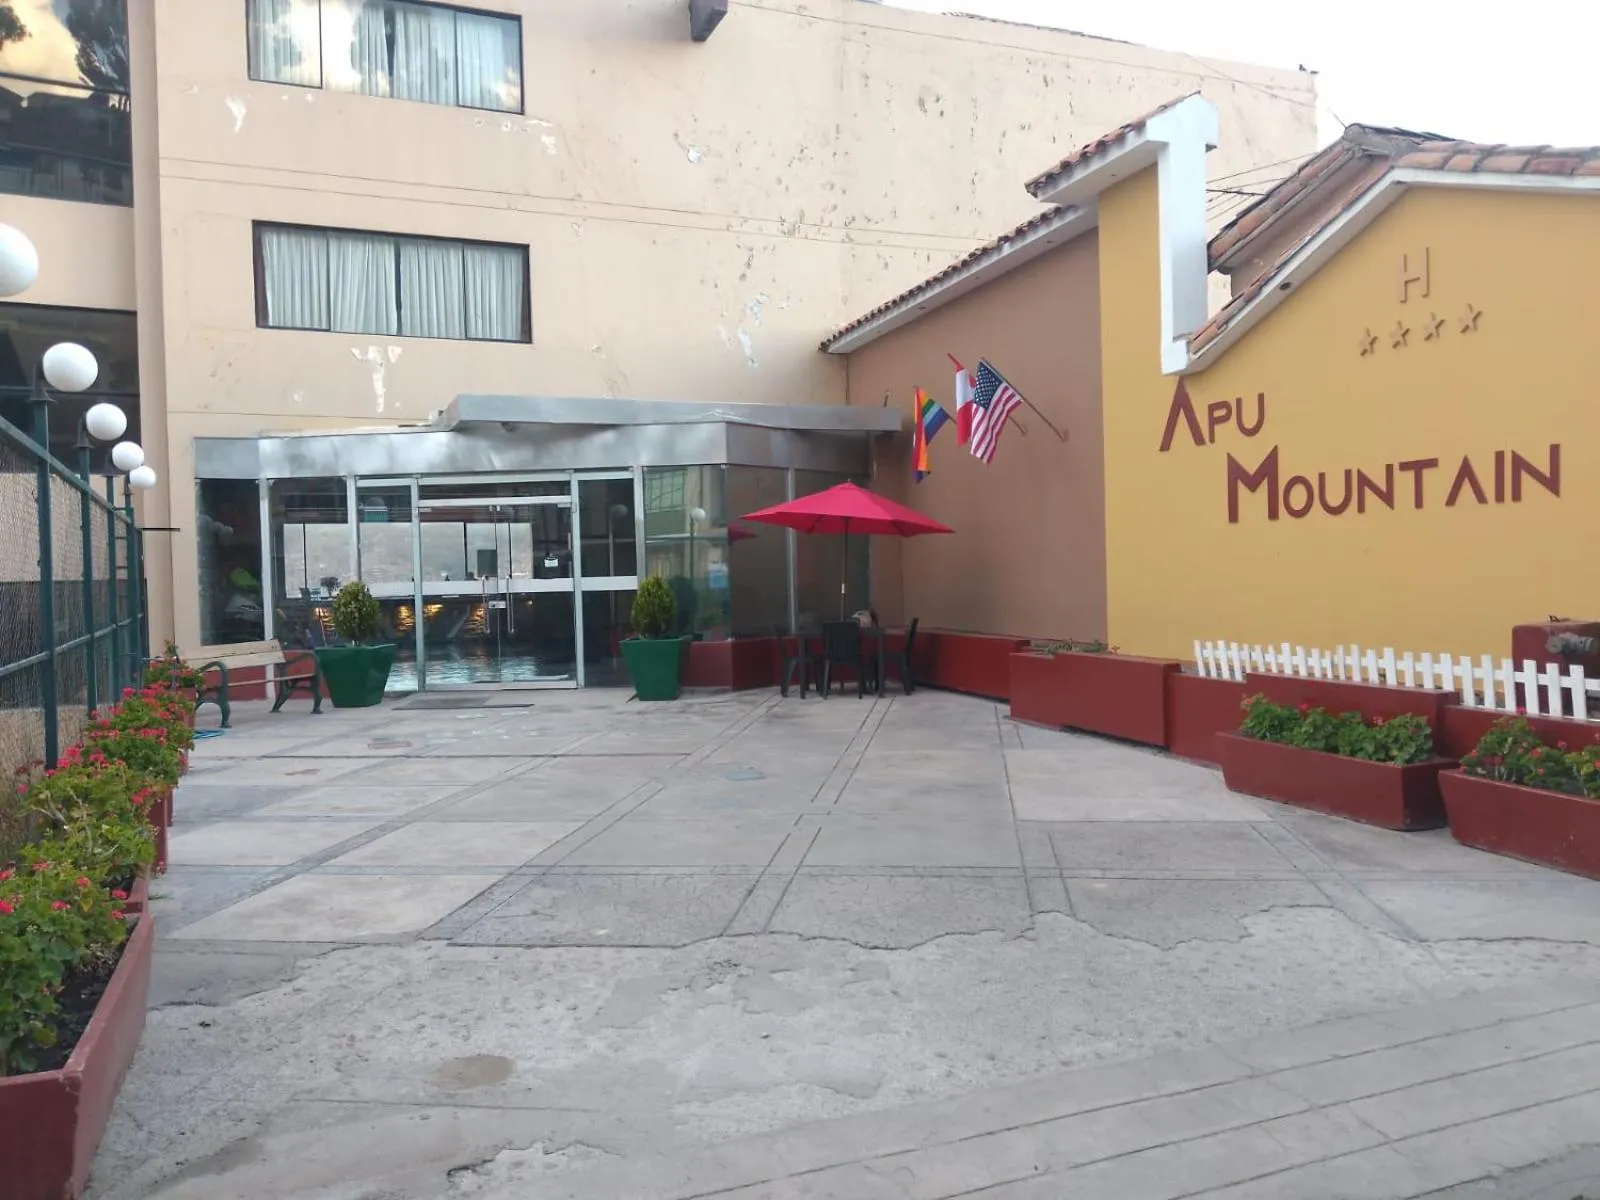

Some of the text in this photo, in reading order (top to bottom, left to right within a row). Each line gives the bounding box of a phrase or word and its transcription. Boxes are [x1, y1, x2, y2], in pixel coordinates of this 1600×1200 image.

[1400, 247, 1431, 303] H
[1159, 375, 1265, 452] APU
[1226, 443, 1561, 524] MOUNTAIN
